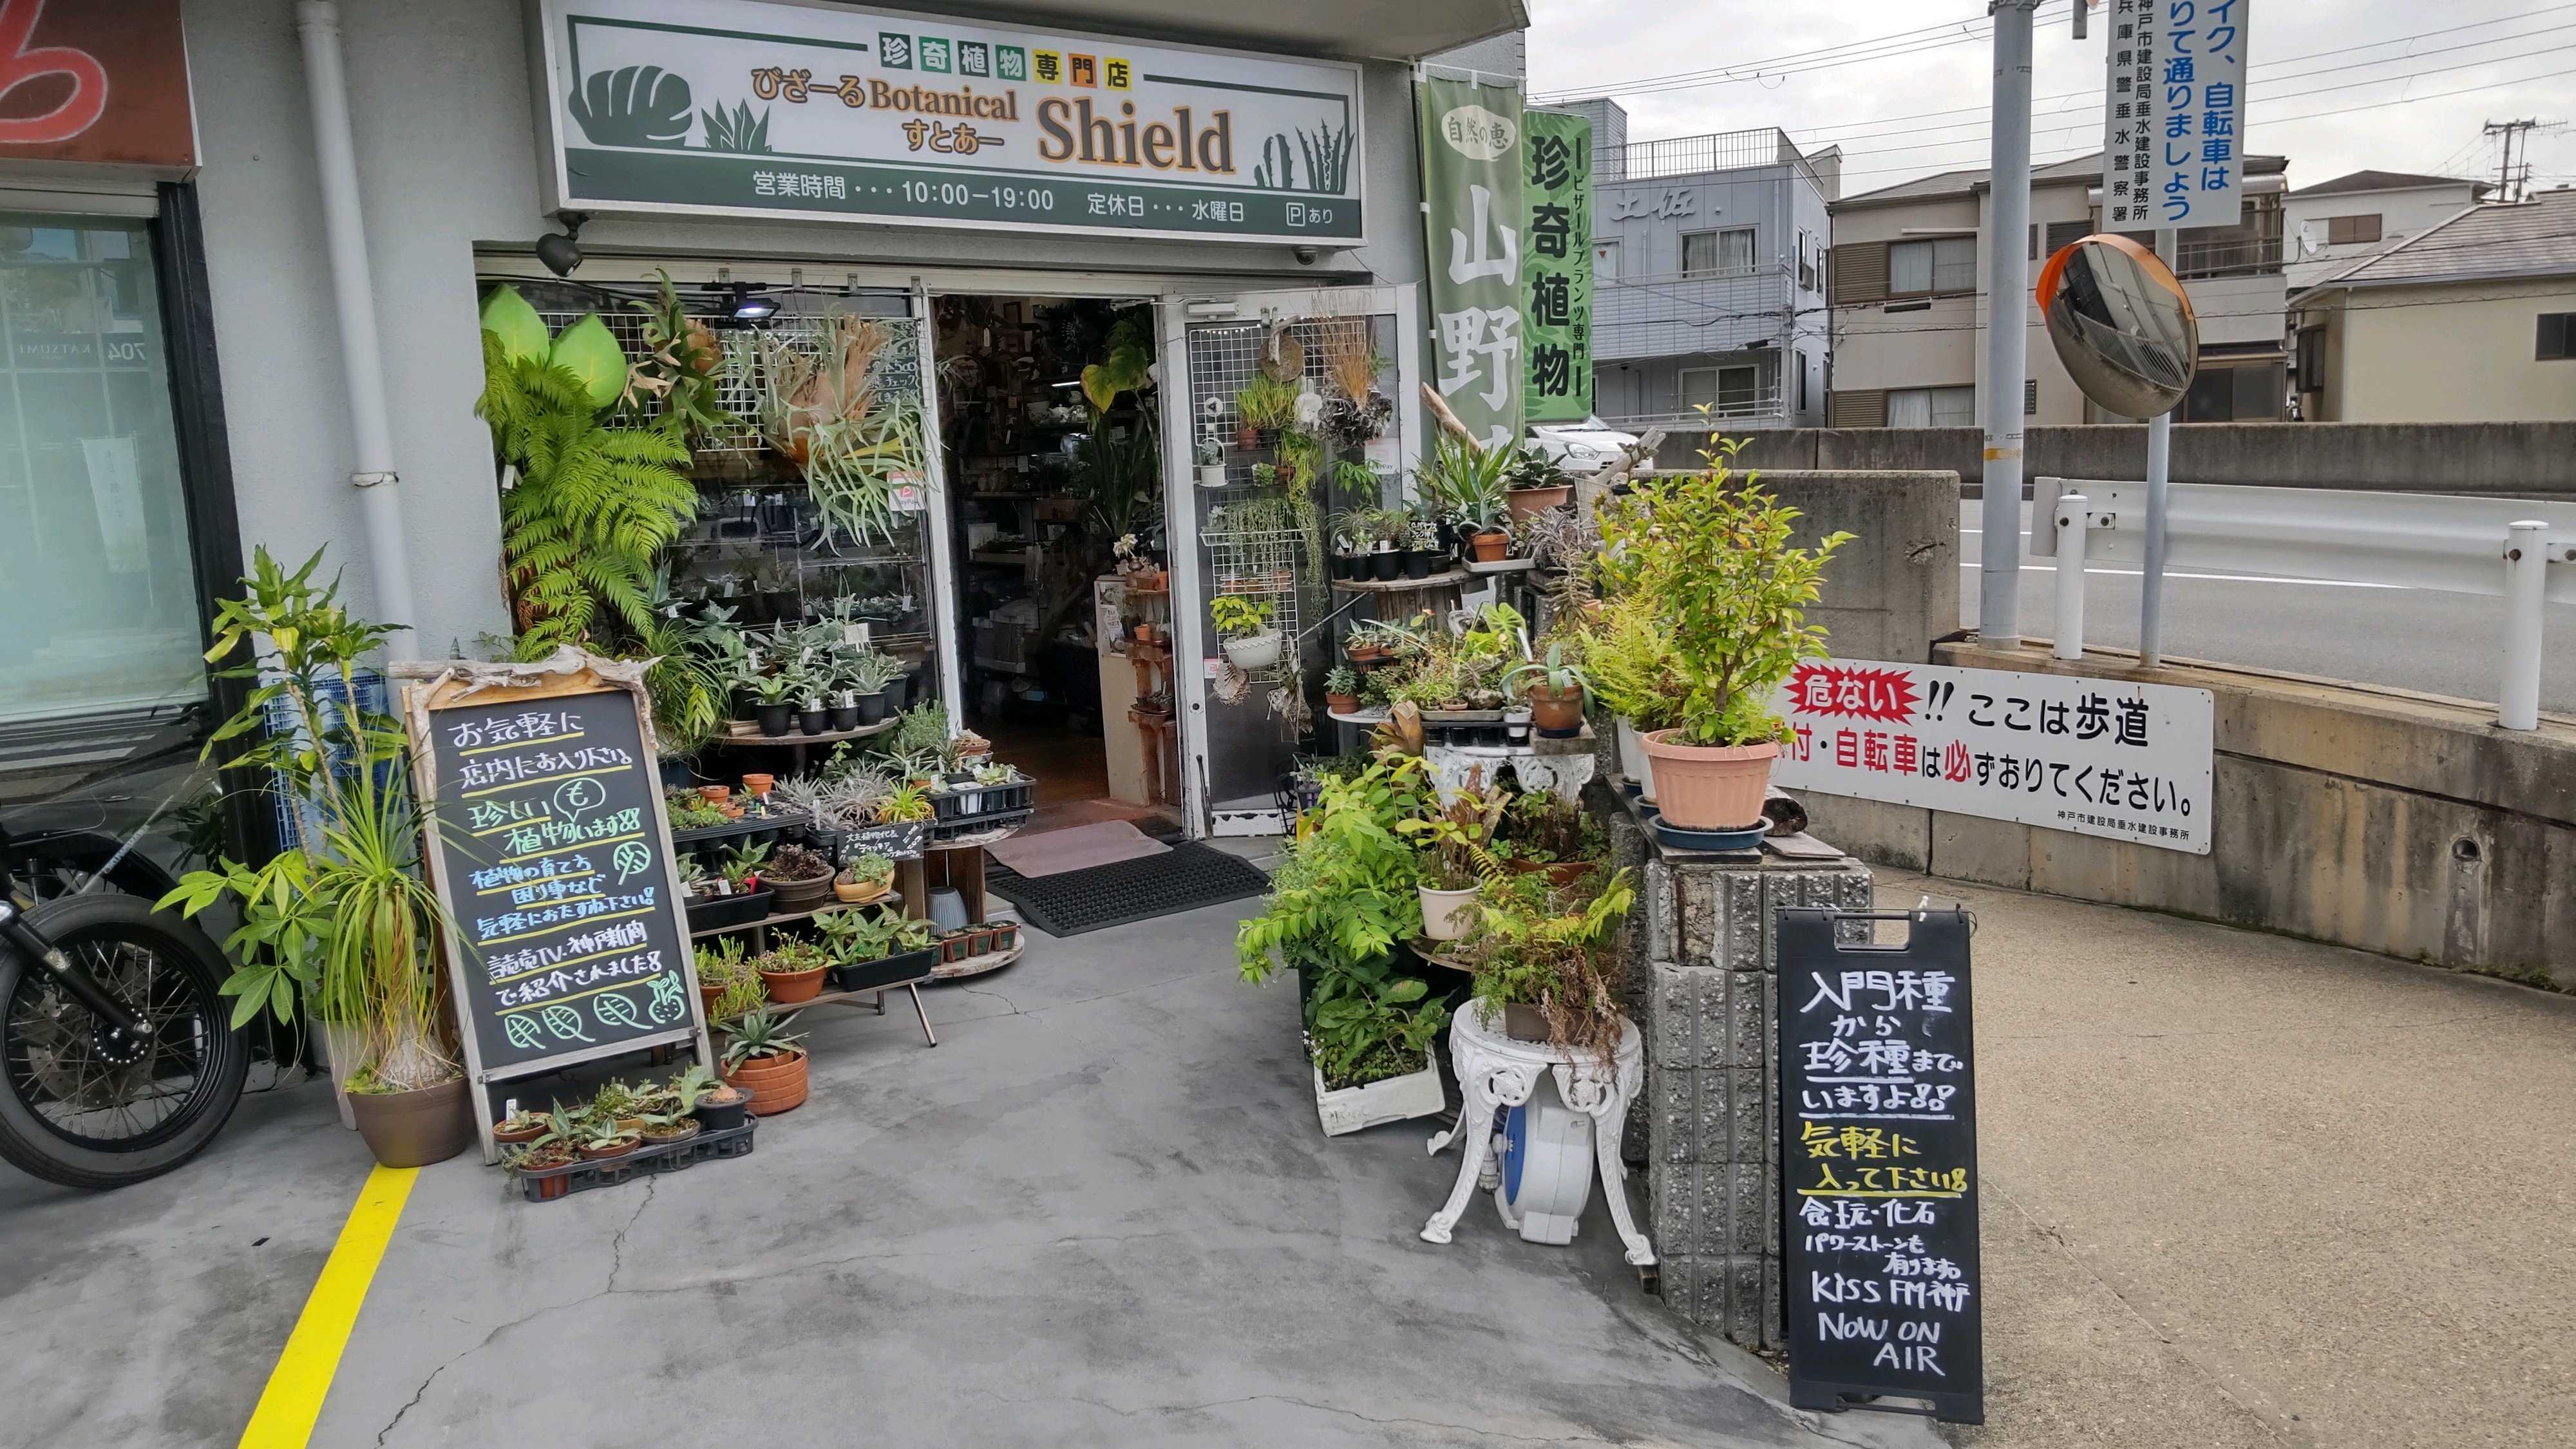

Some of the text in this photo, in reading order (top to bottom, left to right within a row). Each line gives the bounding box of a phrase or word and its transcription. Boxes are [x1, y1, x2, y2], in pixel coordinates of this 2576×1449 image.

[880, 34, 1130, 89] 珍奇植物専門店
[868, 79, 1019, 122] Botanical
[902, 118, 1005, 156] すとあー
[1036, 96, 1236, 175] Shield
[1531, 135, 1571, 397] 珍奇植物
[447, 712, 584, 747] お気軽に
[1773, 721, 2191, 817] 付・自転車は必ずおりてください。
[2057, 810, 2190, 841] 神戸市建設局垂水建設事務所
[1799, 971, 1956, 1012] 入門種
[1830, 1014, 1902, 1036] から
[1800, 1121, 1922, 1160] 気軽に
[1897, 1321, 1940, 1344] ON
[1873, 1342, 1946, 1376] AIR
